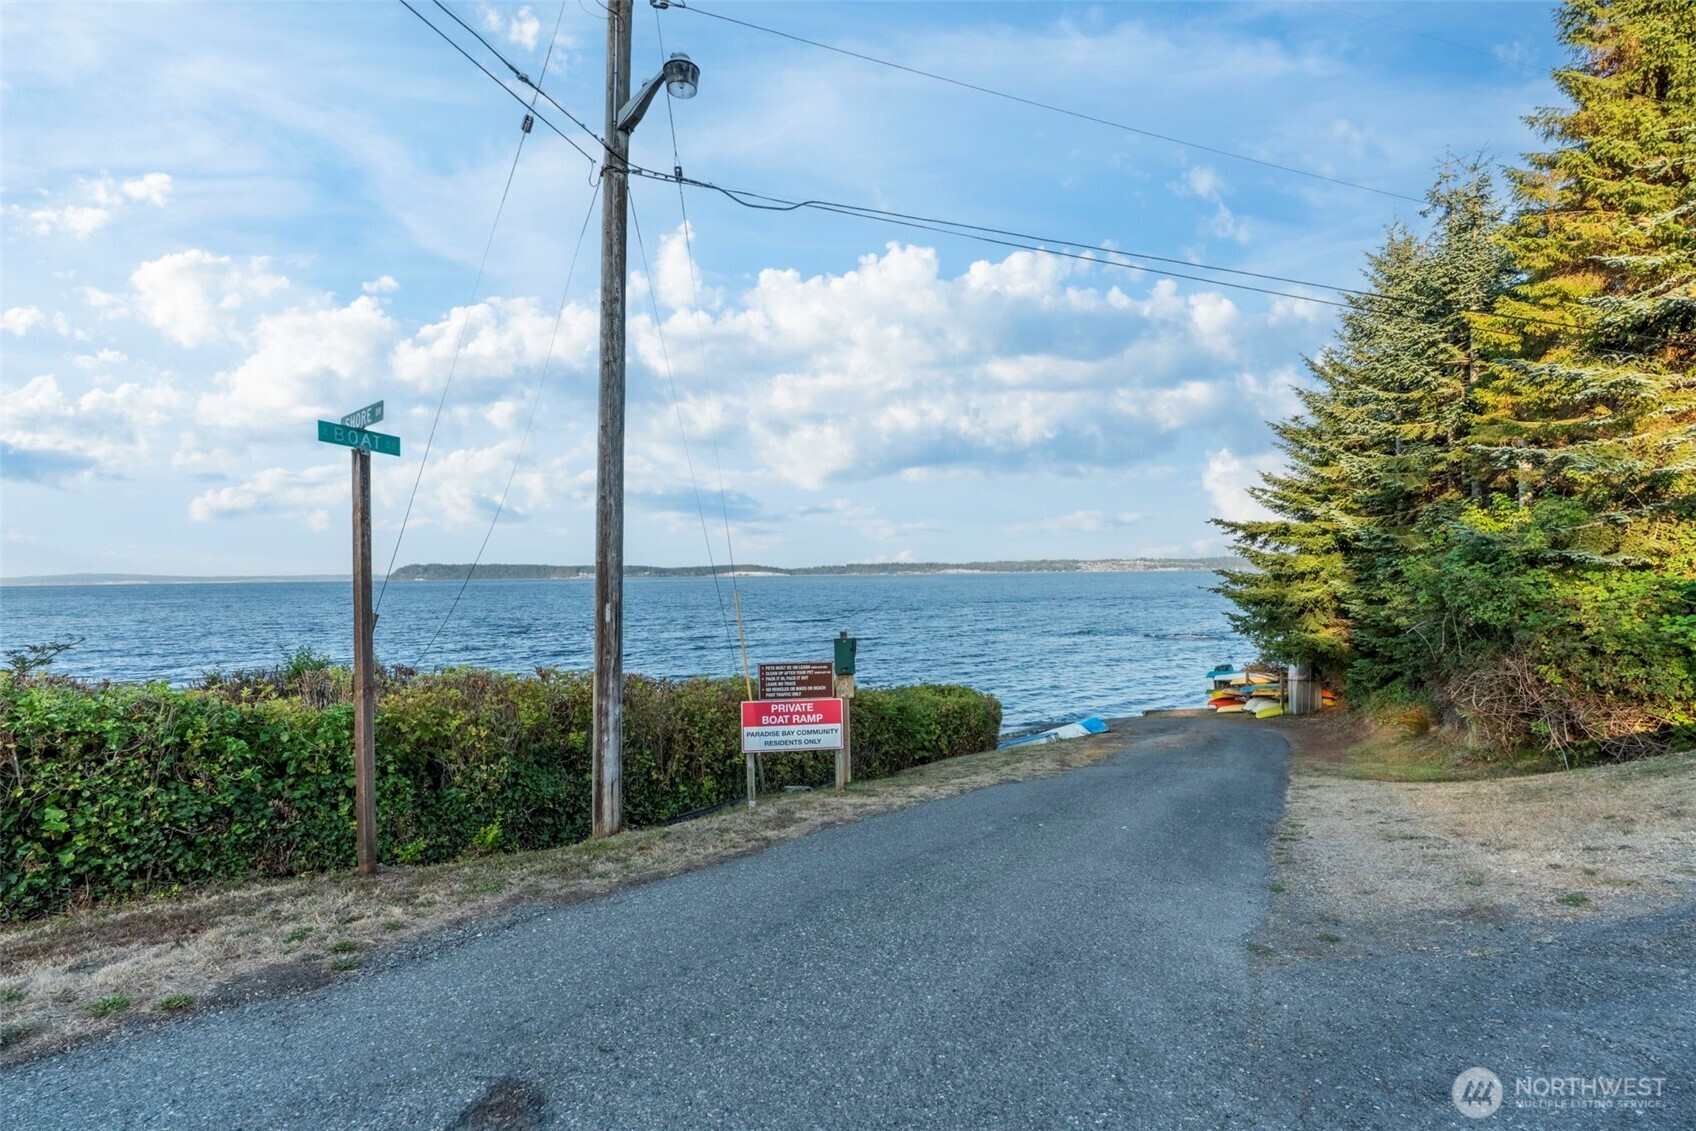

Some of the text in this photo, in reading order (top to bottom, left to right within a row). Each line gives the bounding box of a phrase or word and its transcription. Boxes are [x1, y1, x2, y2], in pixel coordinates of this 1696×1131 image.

[345, 408, 372, 428] SHORE
[334, 427, 382, 449] BOAT
[771, 703, 814, 713] PRIVATE
[762, 713, 823, 725] BOAT RAMP
[746, 730, 780, 738] PARADISE
[796, 728, 839, 736] COMMUNITY
